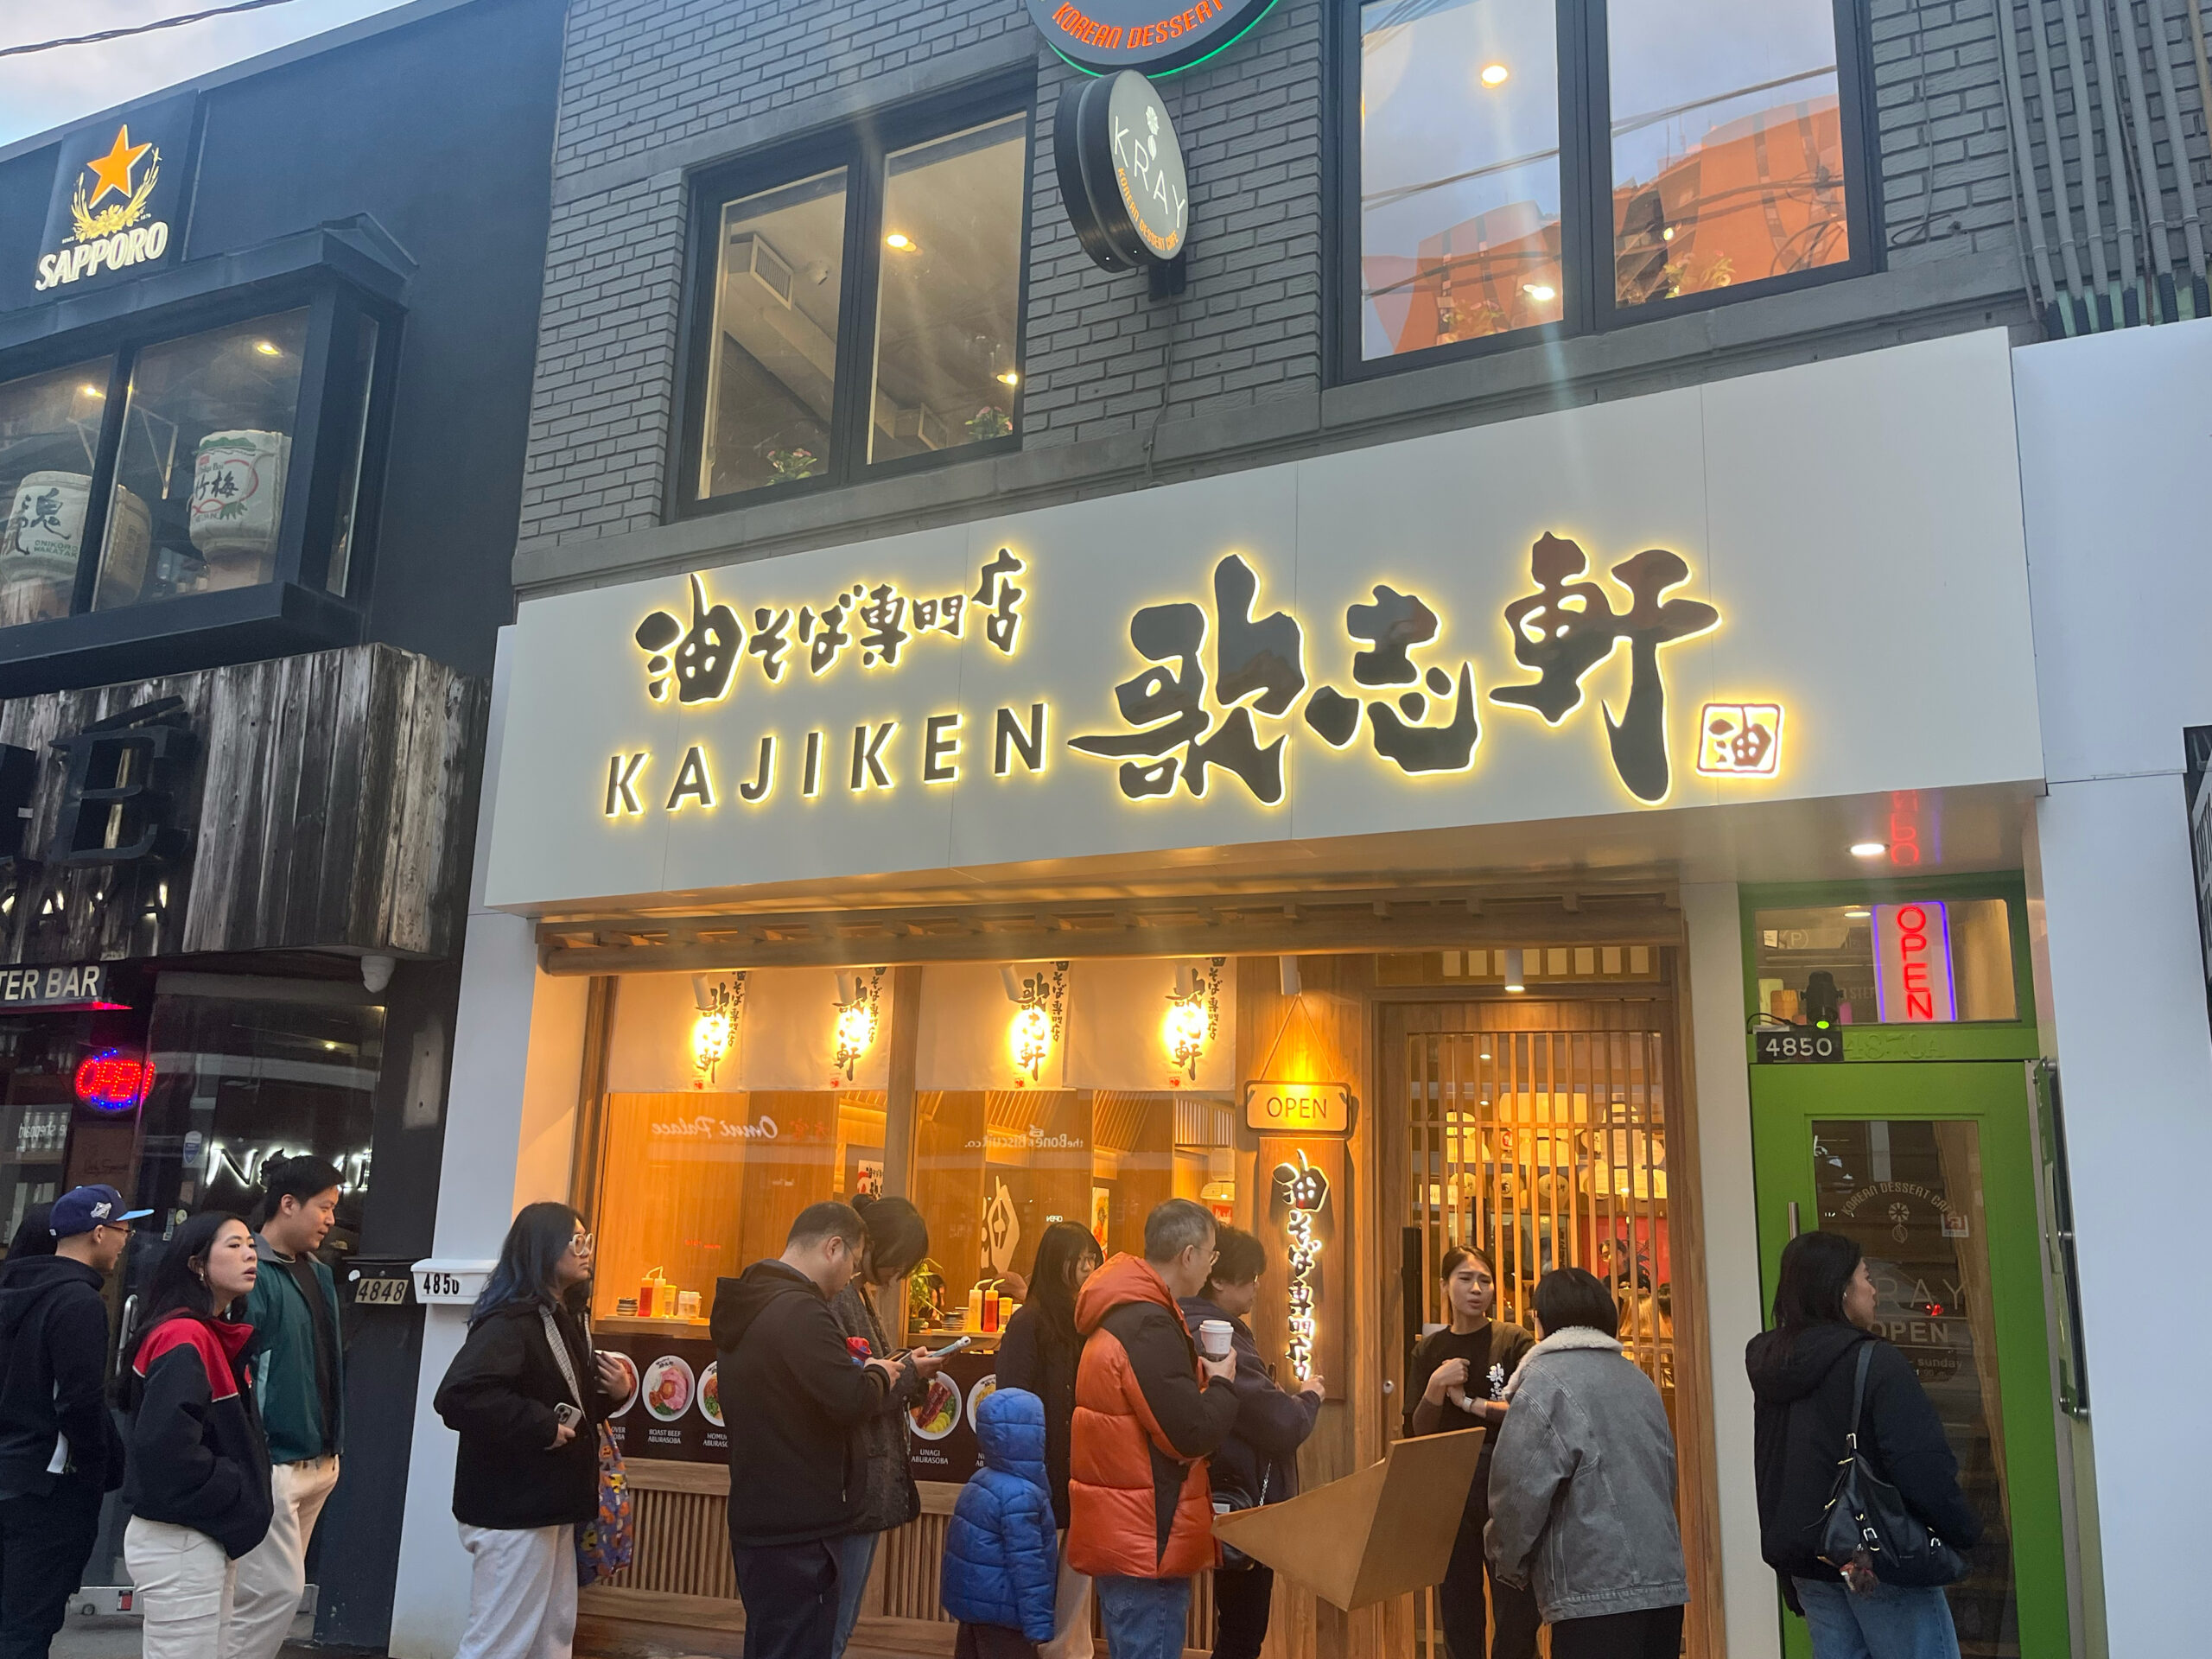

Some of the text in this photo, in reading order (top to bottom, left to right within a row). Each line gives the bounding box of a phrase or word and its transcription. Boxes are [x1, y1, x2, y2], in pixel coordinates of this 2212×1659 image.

[1052, 0, 1224, 49] KOREAN DESSERT
[1114, 115, 1186, 229] KRAY
[1117, 167, 1140, 222] KOREAN
[1138, 218, 1166, 251] DESSERT
[35, 221, 168, 291] SAPPORO
[634, 548, 1028, 706] 油そば専門店
[1065, 531, 1724, 806] 歌志軒
[604, 702, 1050, 819] KAJIKEN
[44, 965, 100, 999] BAR
[1896, 906, 1934, 1021] OPEN
[1765, 1038, 1833, 1057] 4850
[1266, 1096, 1328, 1120] OPEN
[1840, 1185, 1878, 1216] KOREAN
[1879, 1181, 1931, 1199] DESSERT
[358, 1281, 405, 1302] 4848
[1876, 1277, 1965, 1311] RAY
[911, 1456, 949, 1465] ABURASOBA
